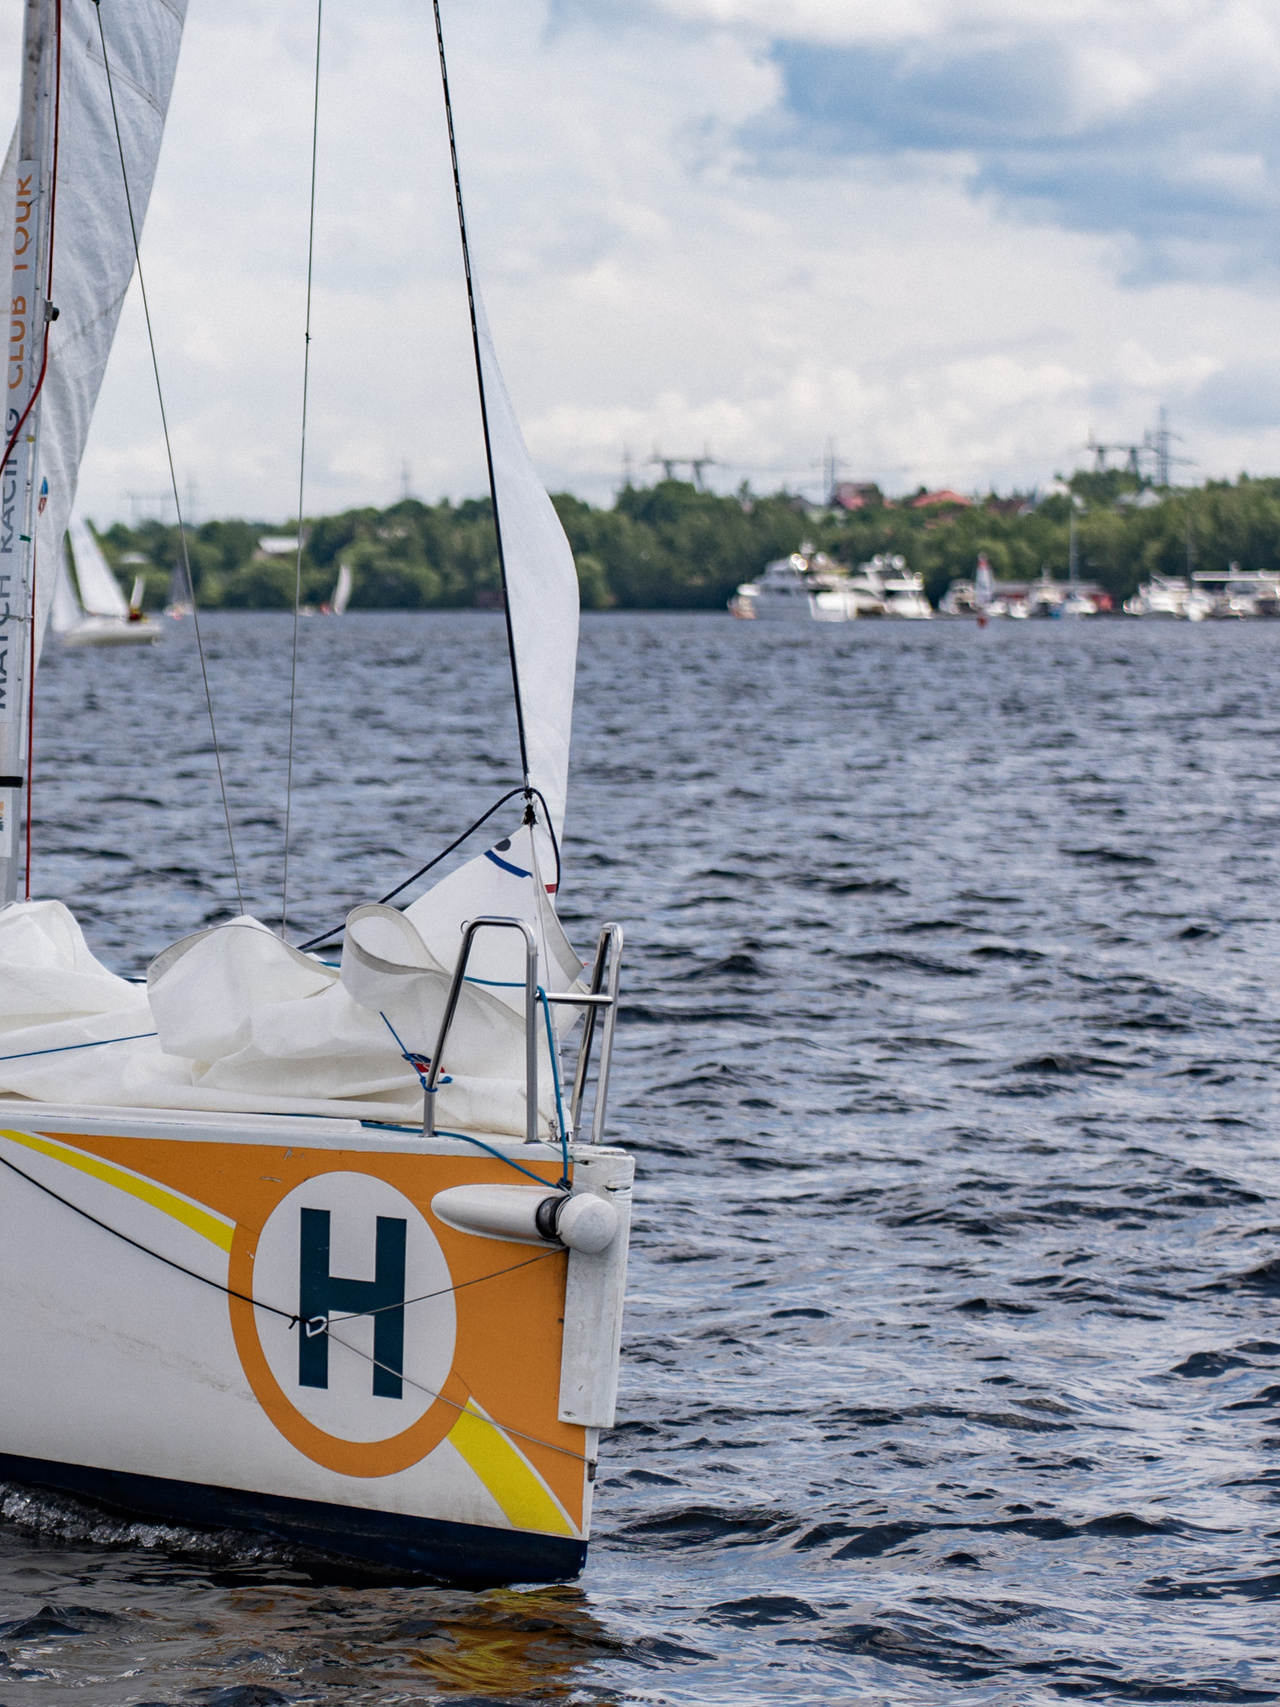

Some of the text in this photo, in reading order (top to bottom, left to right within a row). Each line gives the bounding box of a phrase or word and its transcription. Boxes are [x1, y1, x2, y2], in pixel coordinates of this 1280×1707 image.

[13, 174, 33, 275] TOUR
[7, 295, 27, 389] CLUB
[299, 1207, 407, 1400] H
